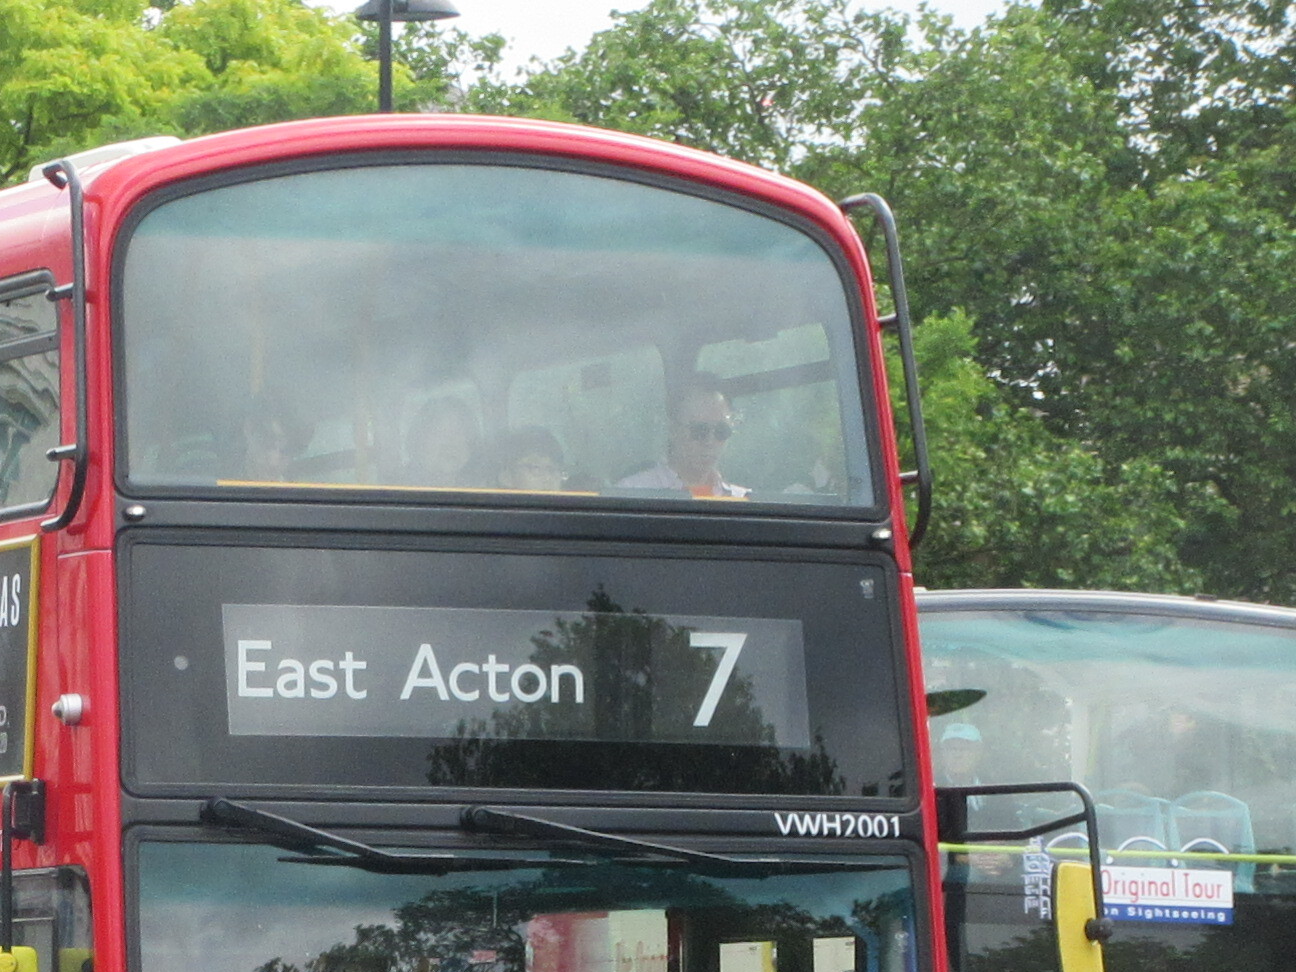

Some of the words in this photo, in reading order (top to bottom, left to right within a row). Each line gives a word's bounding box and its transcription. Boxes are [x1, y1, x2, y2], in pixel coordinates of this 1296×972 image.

[236, 640, 368, 699] East
[400, 642, 585, 704] Acton
[688, 632, 749, 728] 7
[774, 812, 900, 838] VWH2001
[1101, 869, 1176, 903] Original
[1183, 872, 1223, 899] Tour
[1127, 906, 1226, 922] Sightseeing
